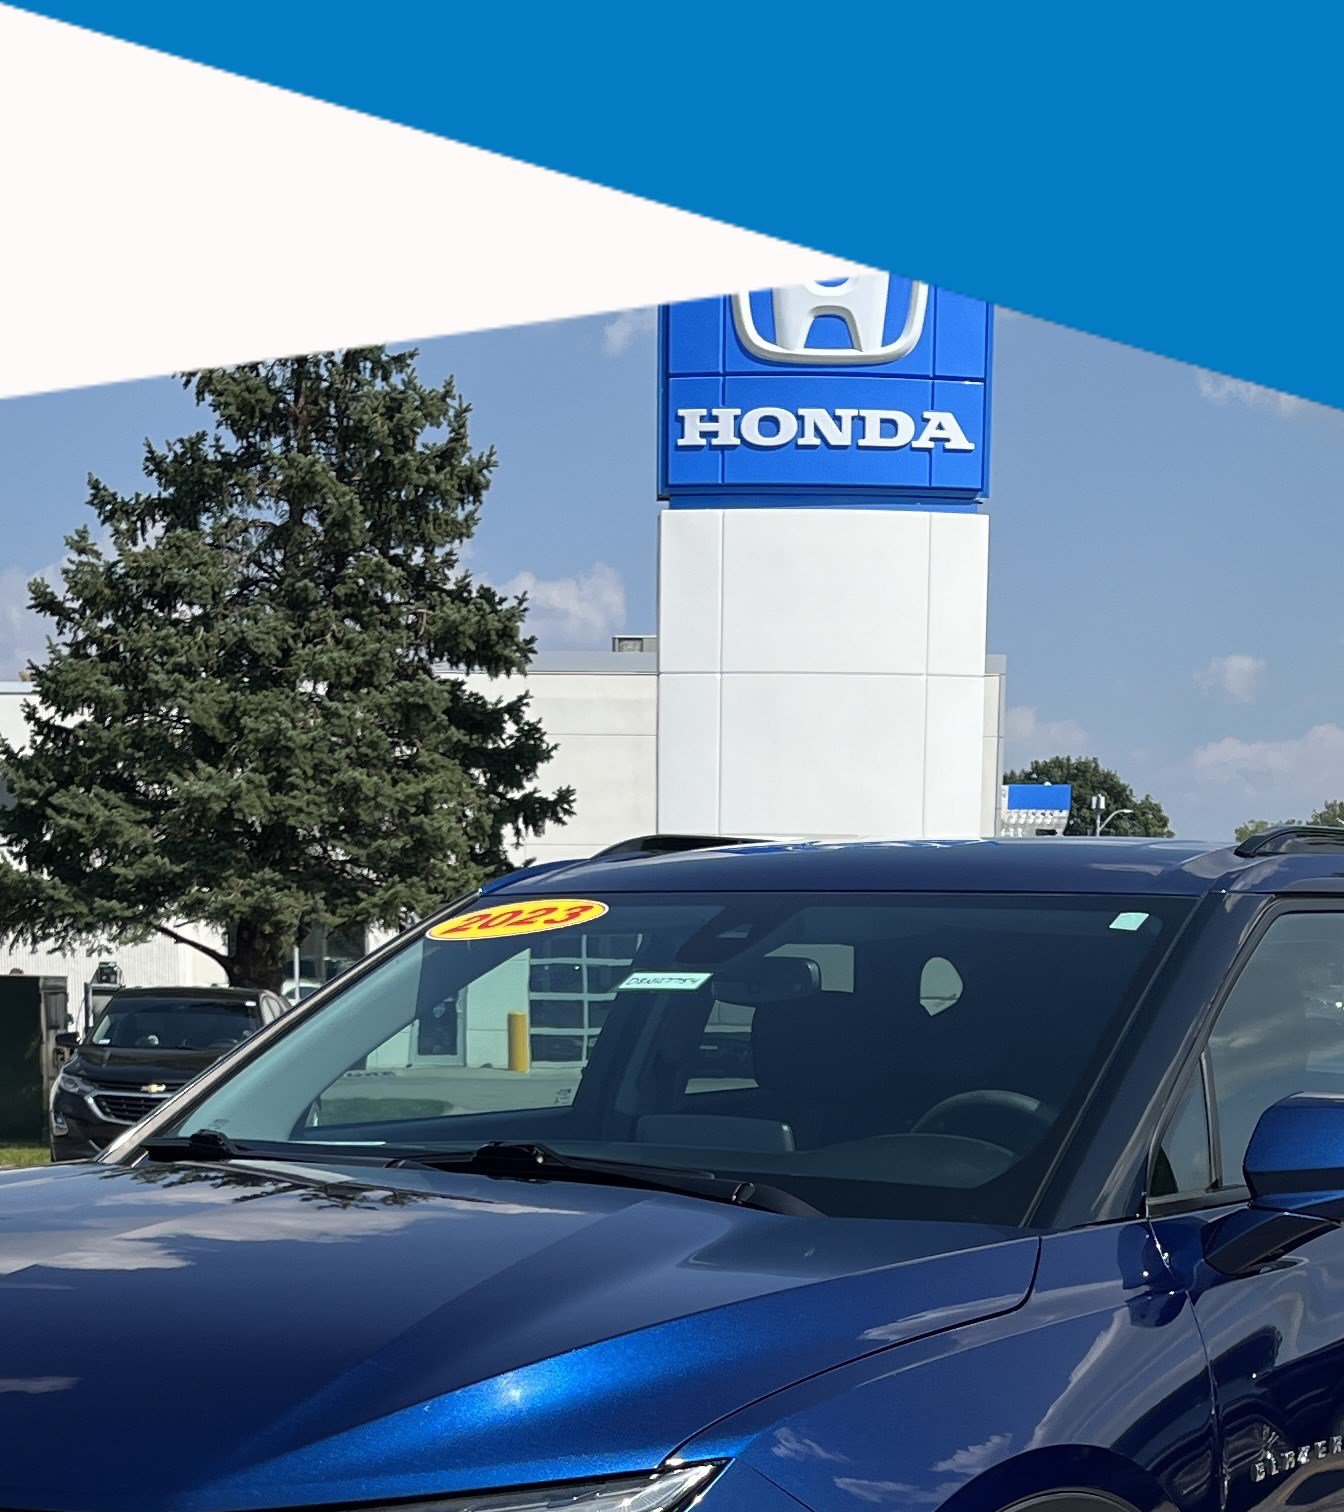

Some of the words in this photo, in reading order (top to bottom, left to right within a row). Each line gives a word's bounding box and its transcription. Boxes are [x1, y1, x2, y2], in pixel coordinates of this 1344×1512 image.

[676, 407, 976, 451] HONDA
[440, 905, 594, 936] 2023
[1254, 1436, 1343, 1482] BLAZER
